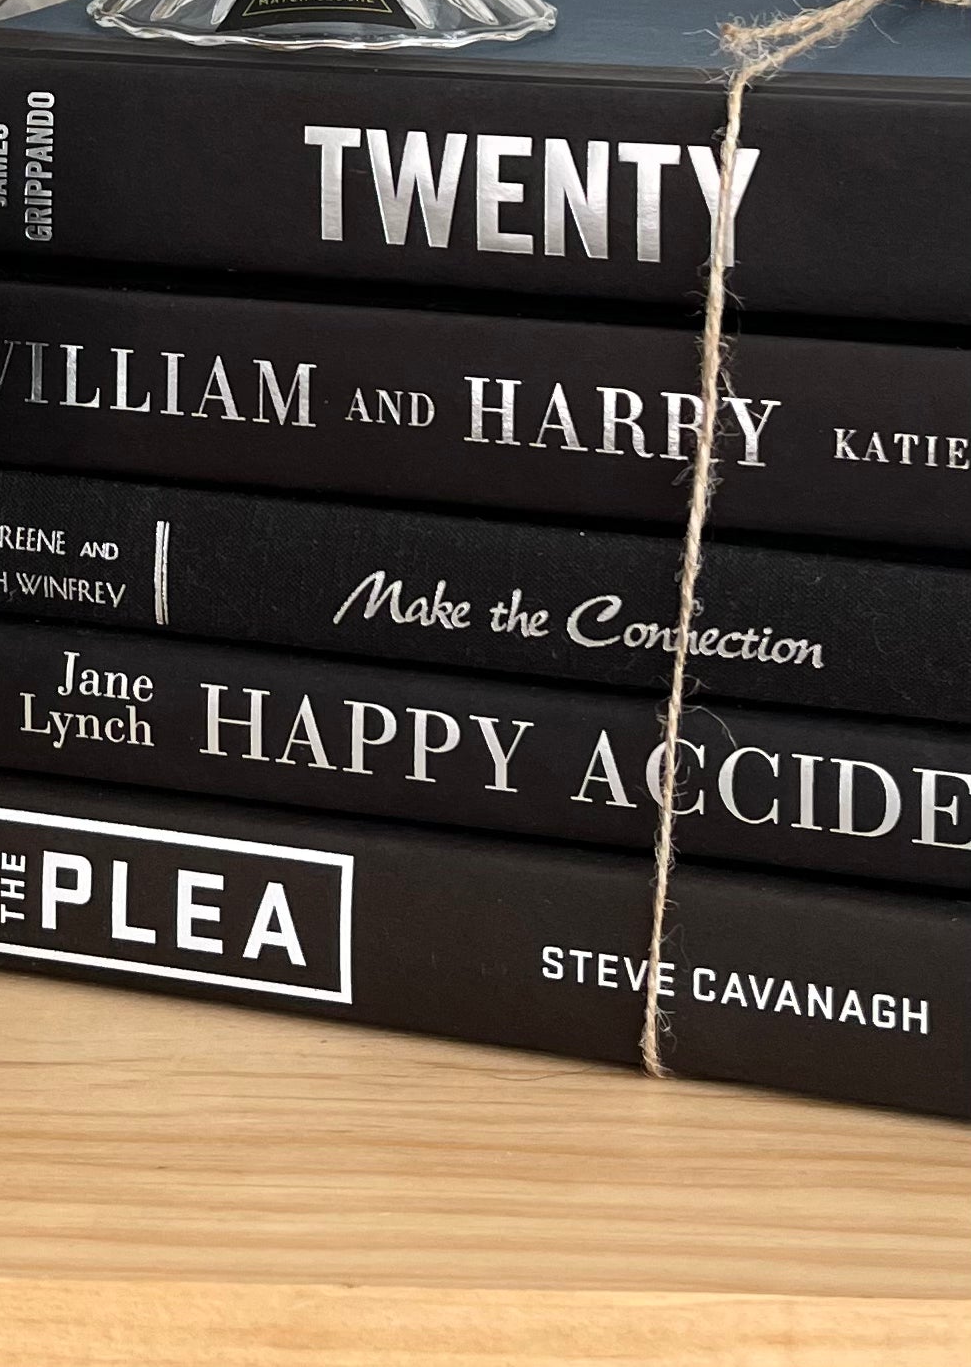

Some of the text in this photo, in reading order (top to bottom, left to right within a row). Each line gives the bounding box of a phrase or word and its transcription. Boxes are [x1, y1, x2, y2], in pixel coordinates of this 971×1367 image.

[24, 91, 55, 242] GRIPPANDO
[305, 126, 760, 267] TWENTY
[345, 388, 435, 427] AND
[463, 376, 782, 467] HARRY
[833, 428, 970, 470] KATIE
[80, 541, 119, 561] AND
[332, 570, 824, 669] Make the Connection
[19, 692, 155, 749] Lynch
[57, 651, 154, 702] Jane
[199, 683, 971, 850] HAPPY ACCIDE
[0, 850, 307, 967] THE PLEA
[542, 946, 928, 1034] STEVE CAVANAGH
